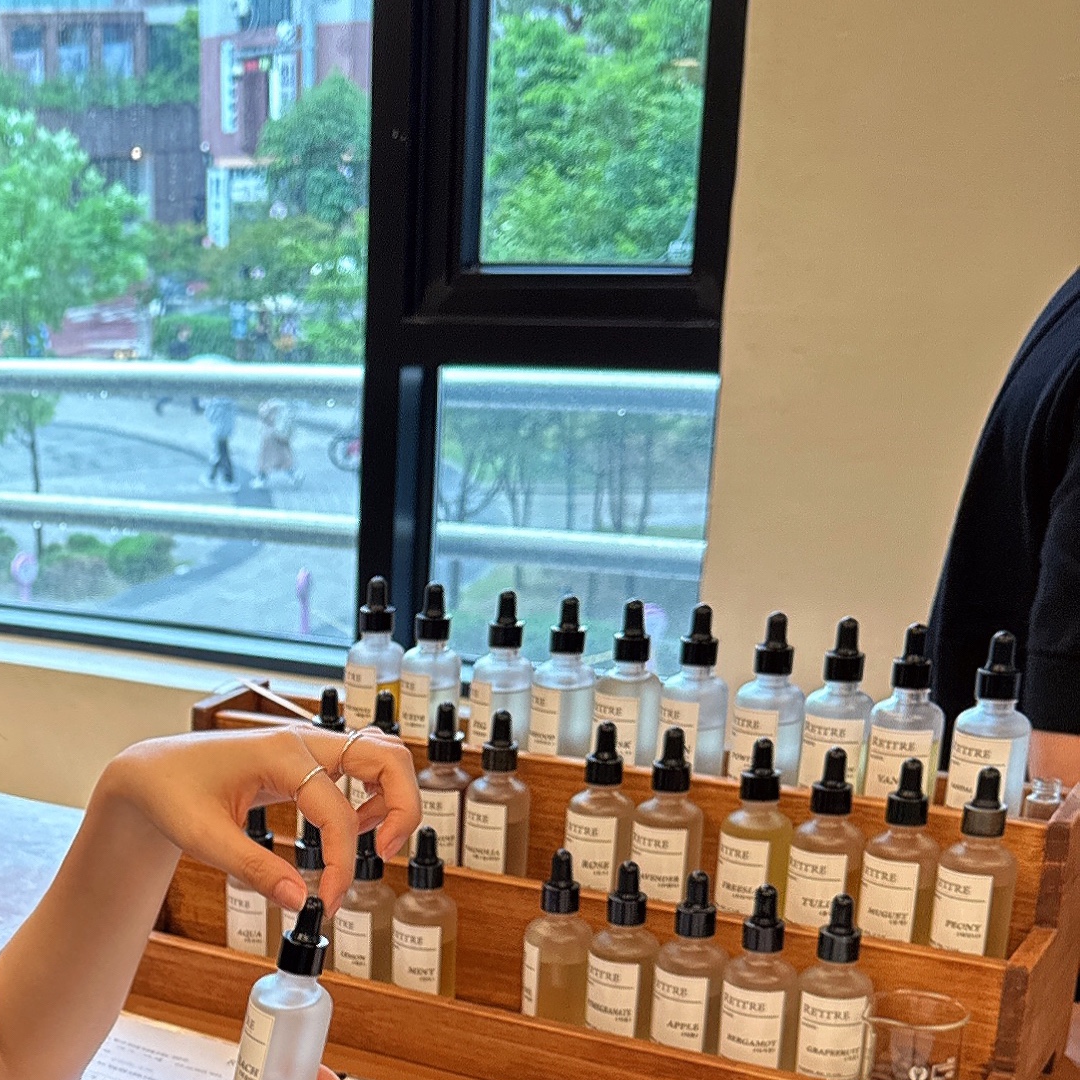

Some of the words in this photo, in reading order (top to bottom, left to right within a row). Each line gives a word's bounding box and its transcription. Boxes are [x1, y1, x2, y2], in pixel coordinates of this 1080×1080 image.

[871, 735, 916, 752] RETTRE
[953, 742, 991, 760] ETTRE
[581, 858, 610, 870] ROSE
[640, 871, 680, 885] AVENDER
[944, 919, 982, 933] PEONY
[237, 928, 262, 939] AQUA
[340, 950, 366, 962] LEMON
[407, 965, 436, 977] MINT
[723, 992, 766, 1012] RETTRE
[802, 1003, 851, 1020] RETTRE
[666, 1019, 700, 1032] APPLE
[726, 1032, 778, 1048] BERGAMOT
[806, 1044, 861, 1058] GRAPEFRUIT
